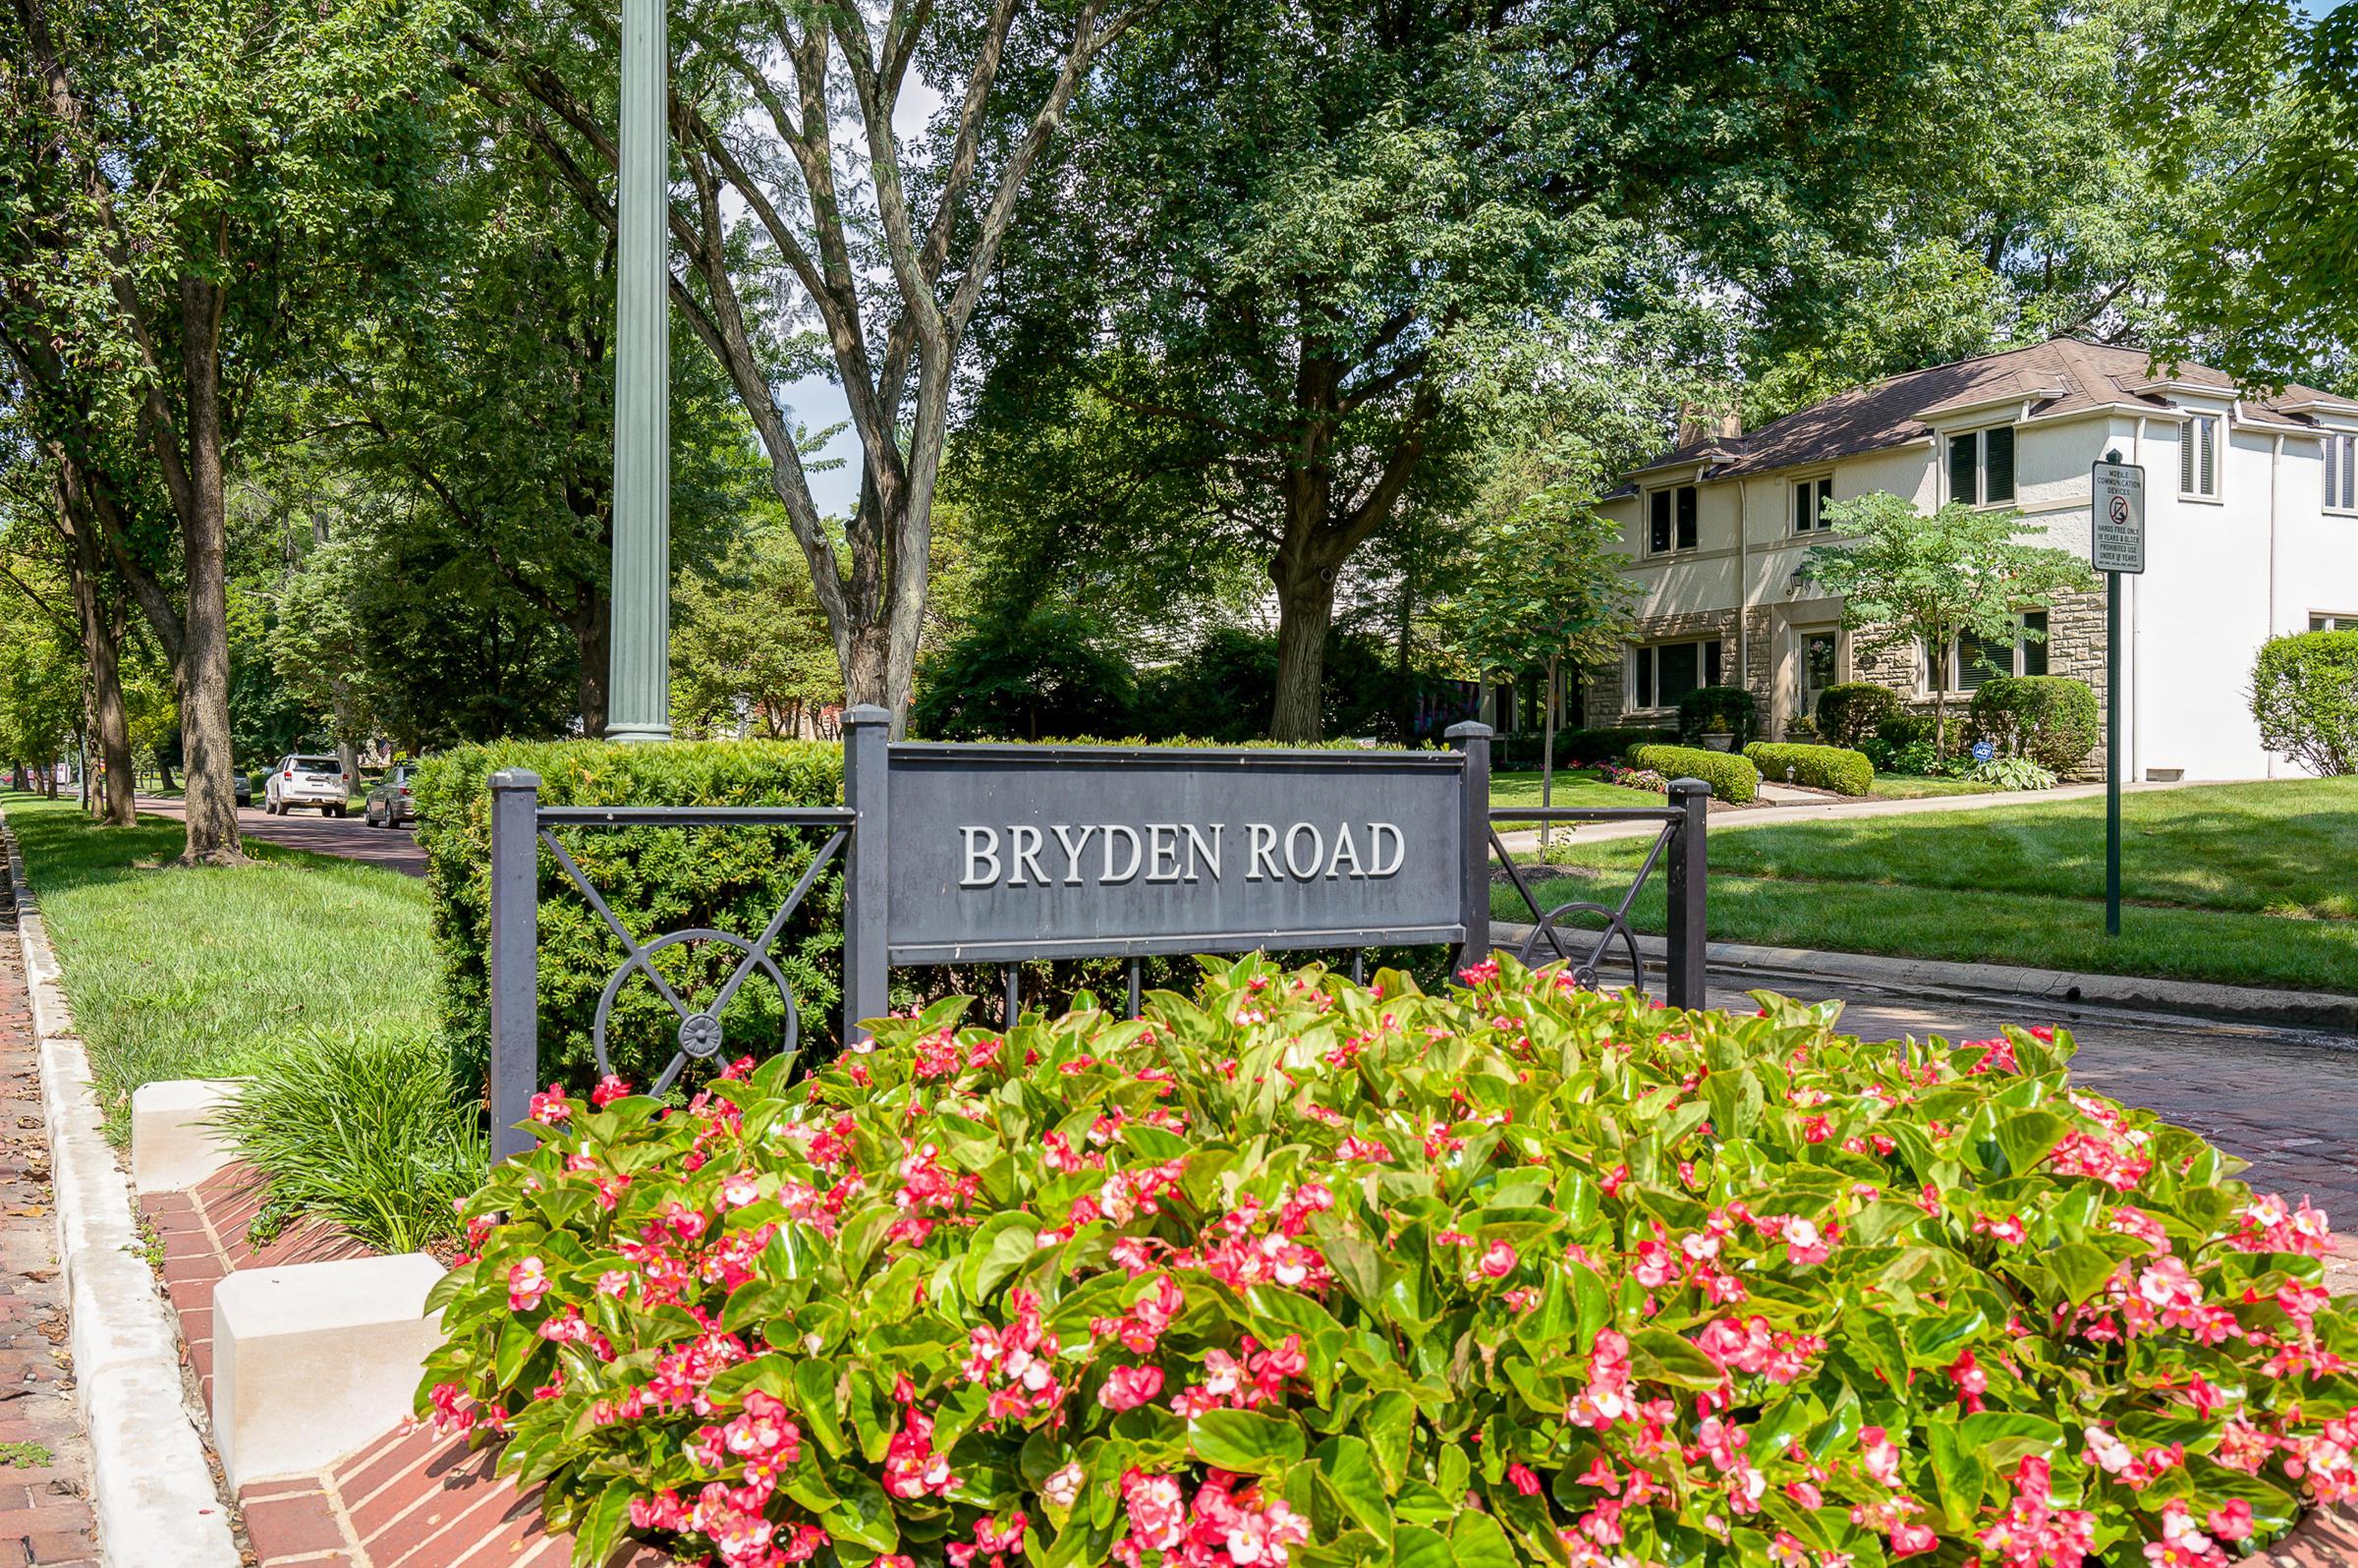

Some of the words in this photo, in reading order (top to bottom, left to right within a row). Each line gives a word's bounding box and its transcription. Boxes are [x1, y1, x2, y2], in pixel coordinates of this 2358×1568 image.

[2108, 470, 2129, 478] MOBILE
[2097, 476, 2141, 488] COMMUNICATION
[2107, 486, 2130, 496] DEVICES
[2098, 524, 2113, 532] HANDS
[2100, 543, 2126, 553] PROHIBITED
[959, 823, 1225, 886] BRYDEN
[1245, 821, 1405, 881] ROAD
